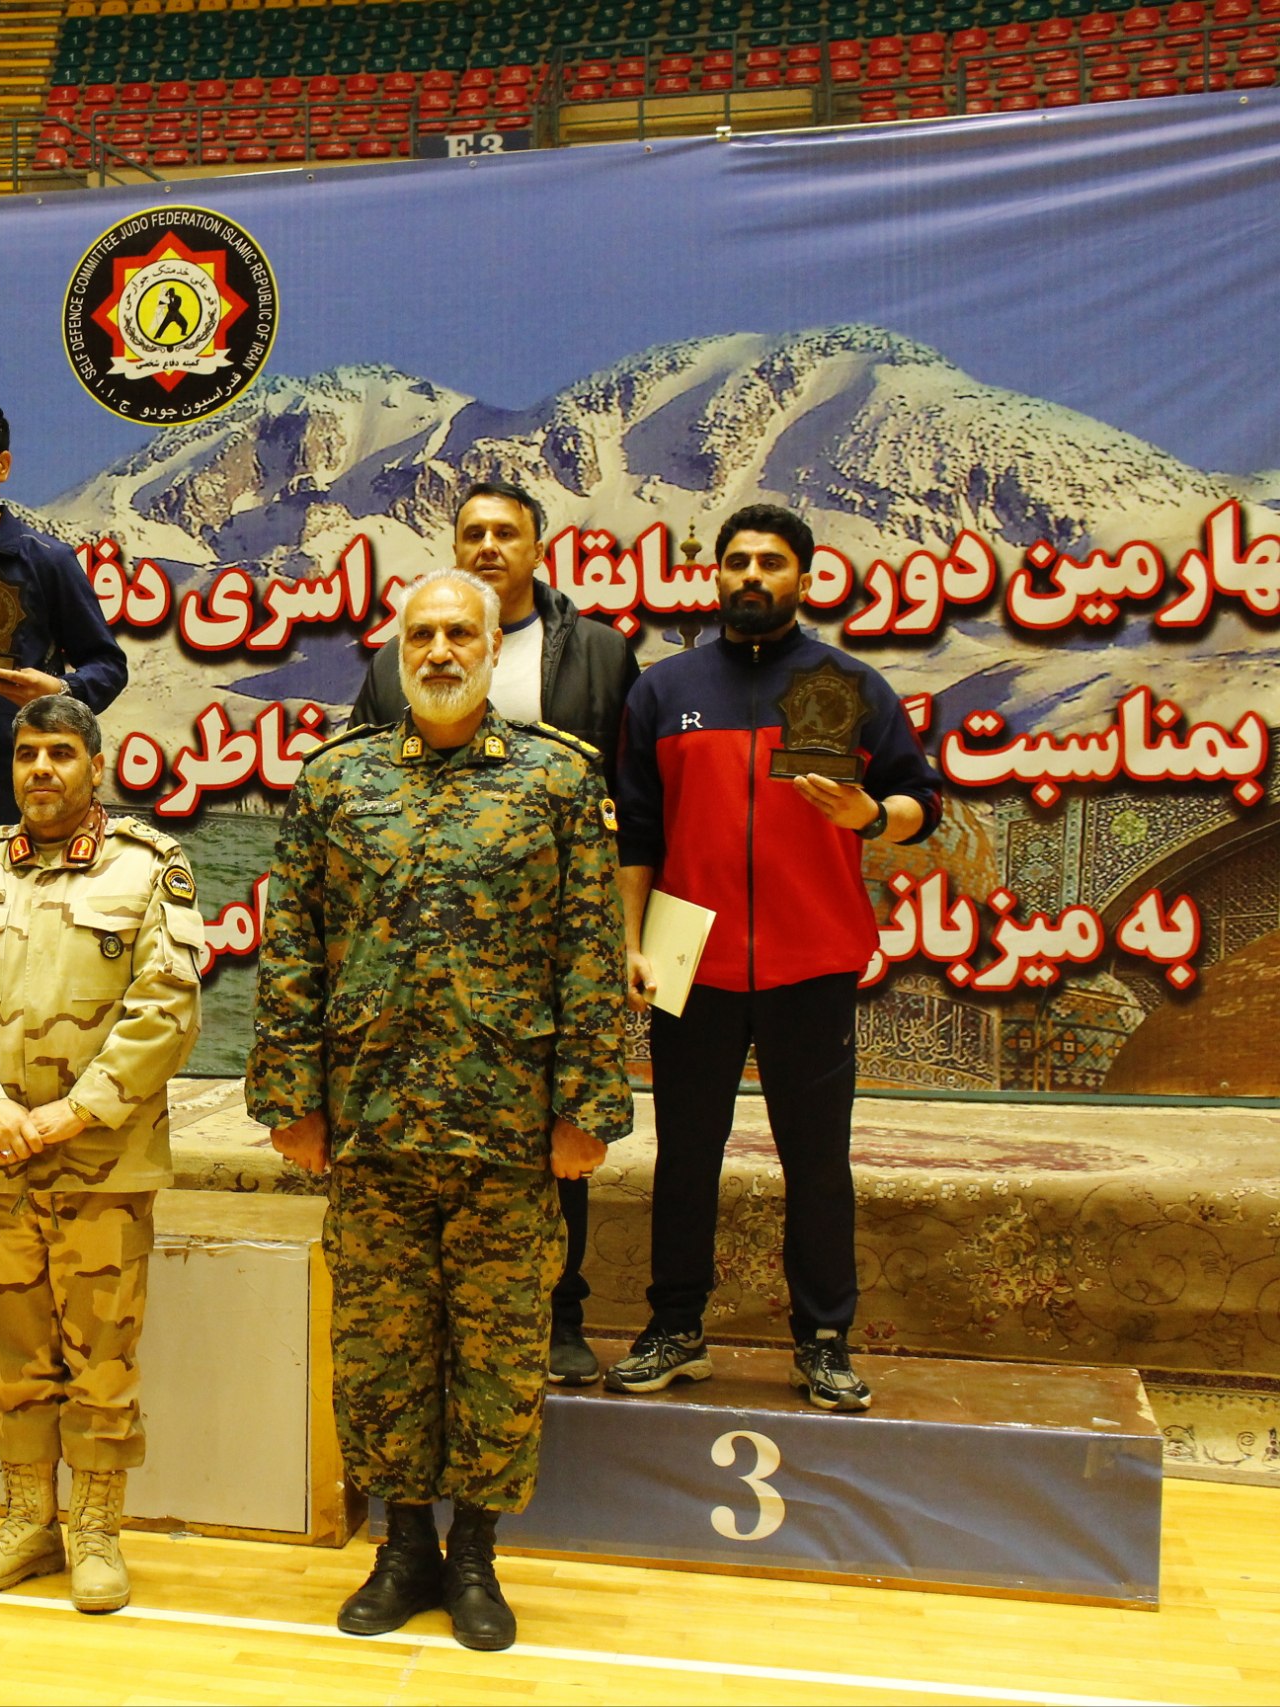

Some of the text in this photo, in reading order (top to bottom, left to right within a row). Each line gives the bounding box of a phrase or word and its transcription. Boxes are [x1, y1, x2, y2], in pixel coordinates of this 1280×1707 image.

[77, 20, 82, 28] 1
[73, 36, 78, 45] 1
[137, 51, 143, 59] 3
[171, 49, 178, 58] 4
[207, 48, 213, 56] 5
[69, 53, 74, 62] 1
[103, 53, 110, 61] 2
[98, 70, 104, 79] 2
[132, 68, 139, 77] 3
[166, 67, 172, 75] 4
[201, 66, 208, 74] 5
[65, 70, 70, 80] 1
[133, 88, 140, 97] 3
[170, 87, 177, 95] 4
[208, 85, 215, 94] 5
[62, 90, 68, 99] 1
[444, 133, 504, 158] E3
[189, 277, 208, 291] علی
[68, 211, 273, 381] SELF DEFENCE COMMITTEE JUDO FEDERATION ISLAMIC REPUBLIC OF IRAN
[135, 357, 201, 370] کمیته دفاع شخصی
[139, 405, 178, 420] جودو
[1008, 499, 1280, 629] هارمین
[74, 537, 171, 627] دفا
[538, 522, 720, 640] سابقا
[808, 529, 997, 637] دوره
[179, 534, 410, 651] راسری
[939, 685, 1269, 808] بمناسبت
[1115, 887, 1201, 991] به
[710, 1429, 786, 1541] 3
